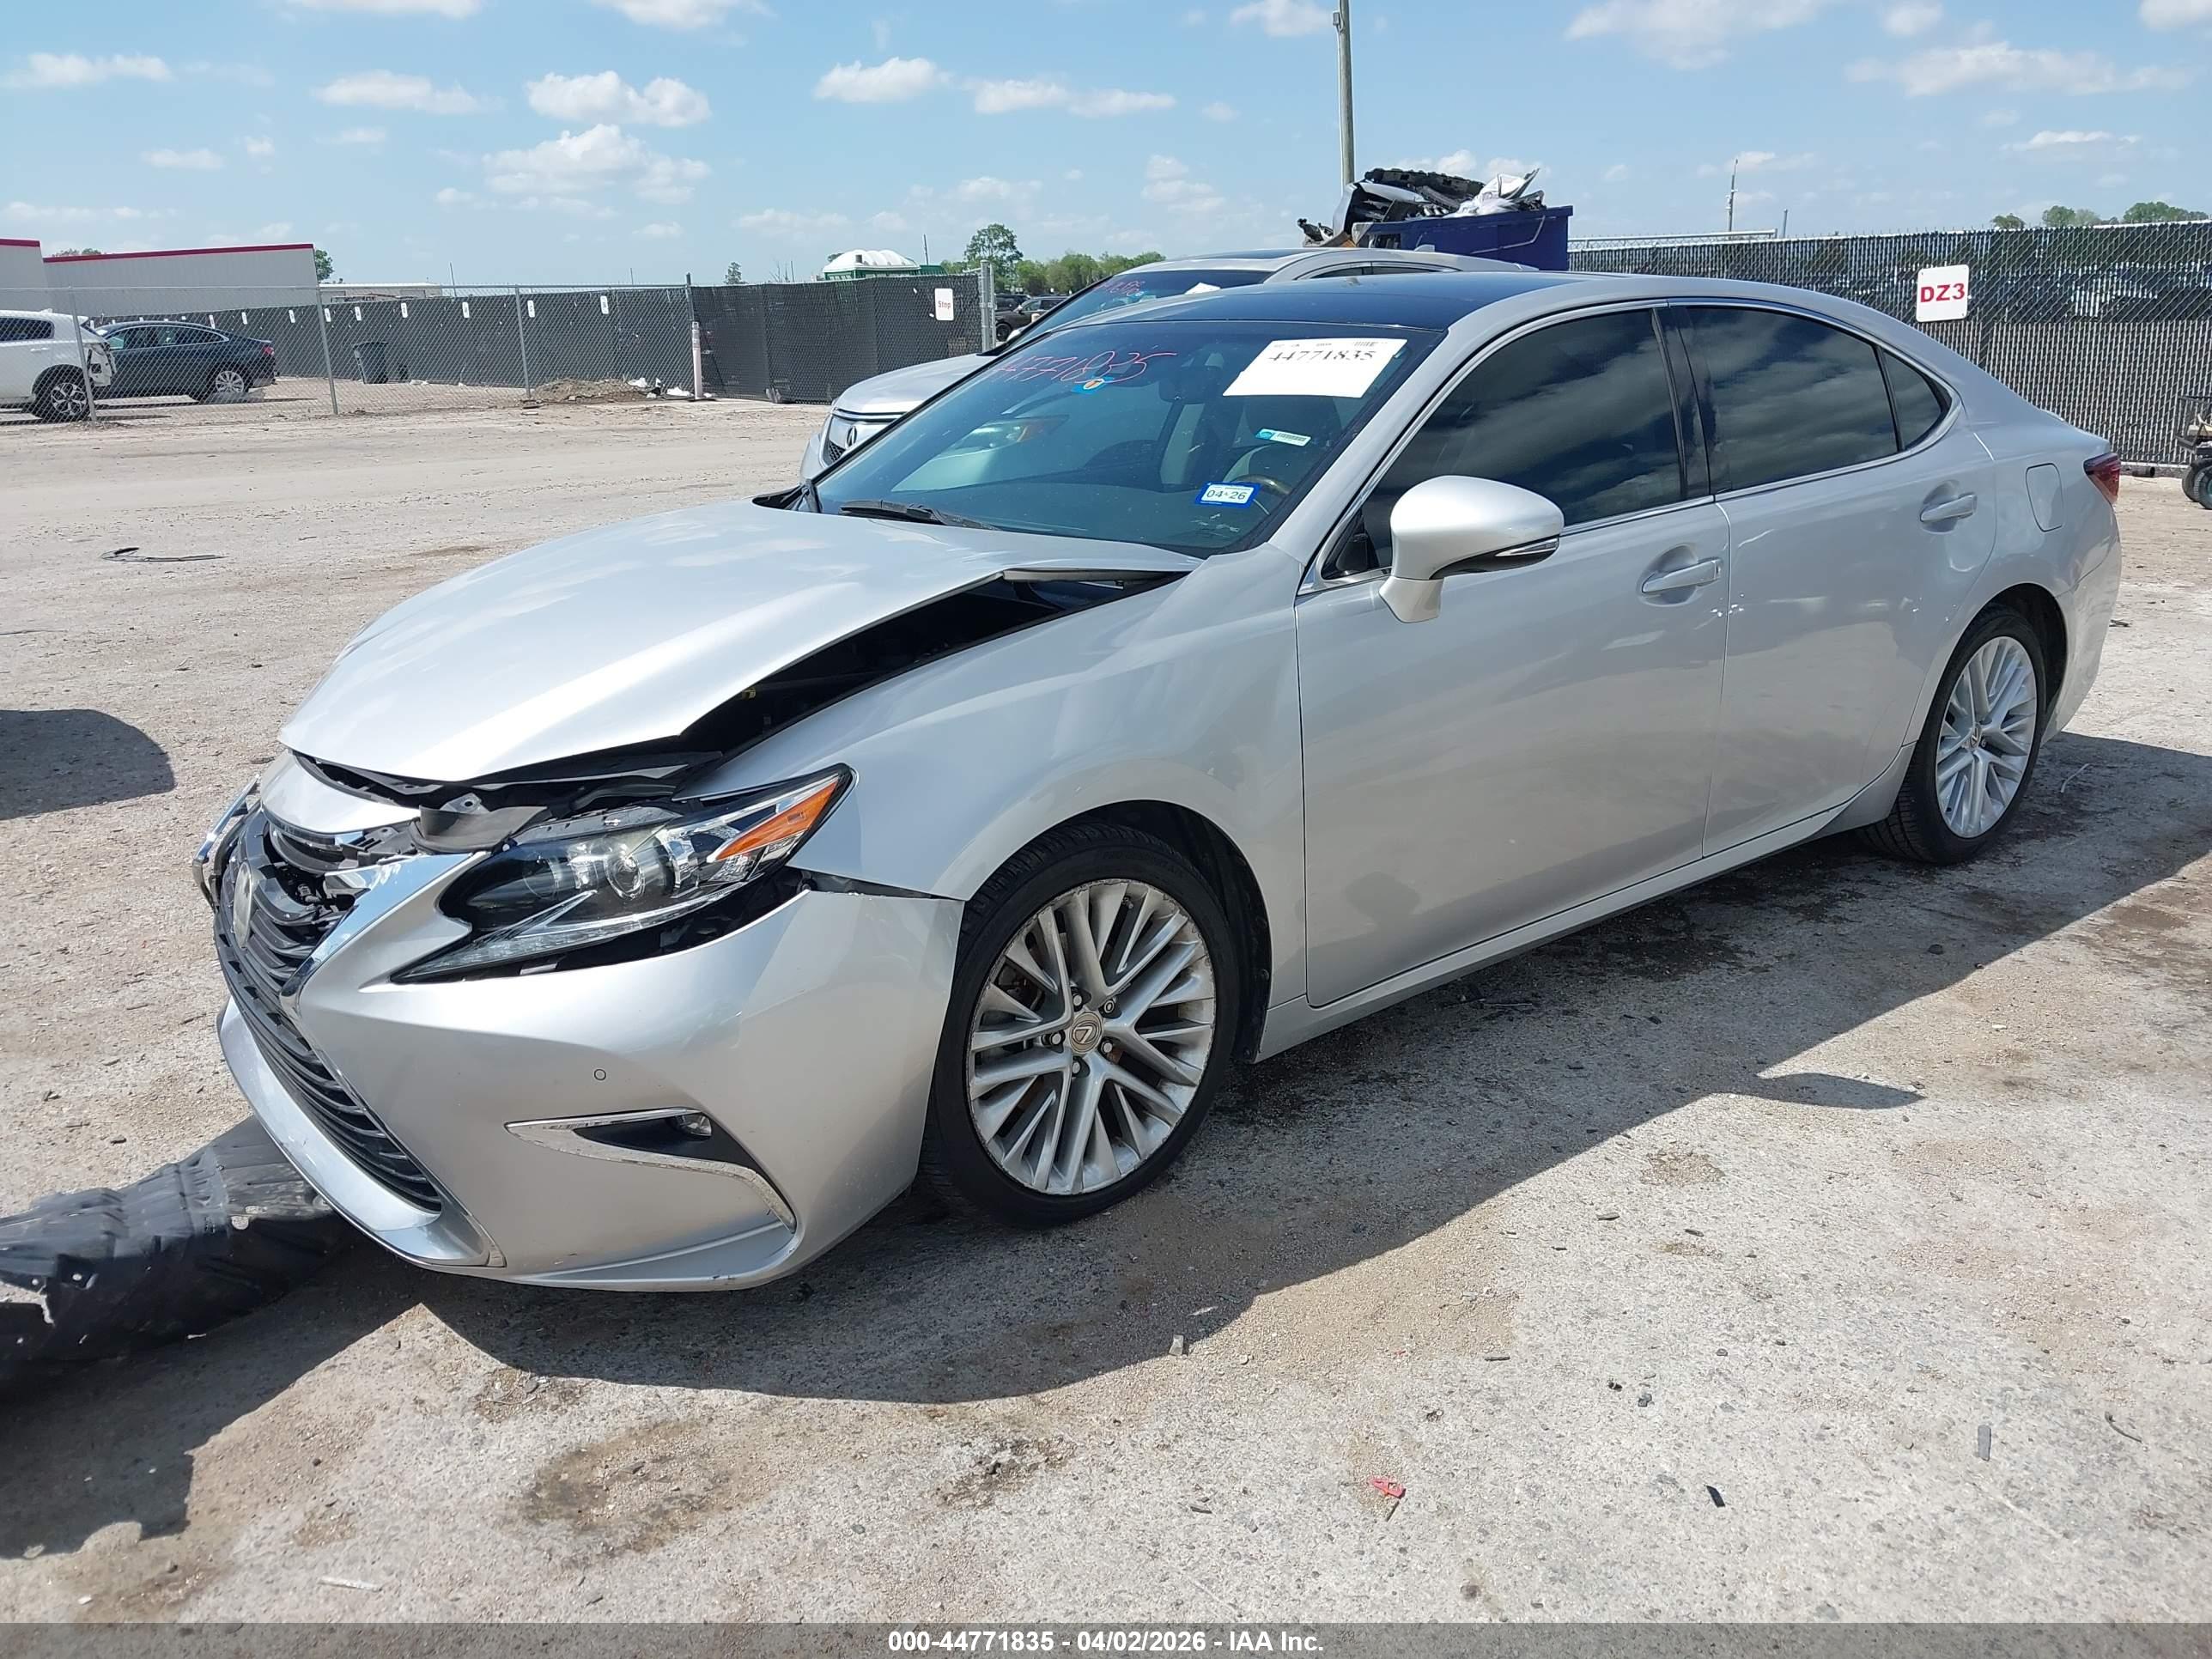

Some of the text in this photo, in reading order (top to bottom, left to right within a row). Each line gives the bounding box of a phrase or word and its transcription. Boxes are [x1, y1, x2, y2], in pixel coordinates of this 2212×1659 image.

[1920, 283, 1966, 302] DZ3
[938, 301, 951, 309] Stop
[1267, 349, 1376, 362] 44771835
